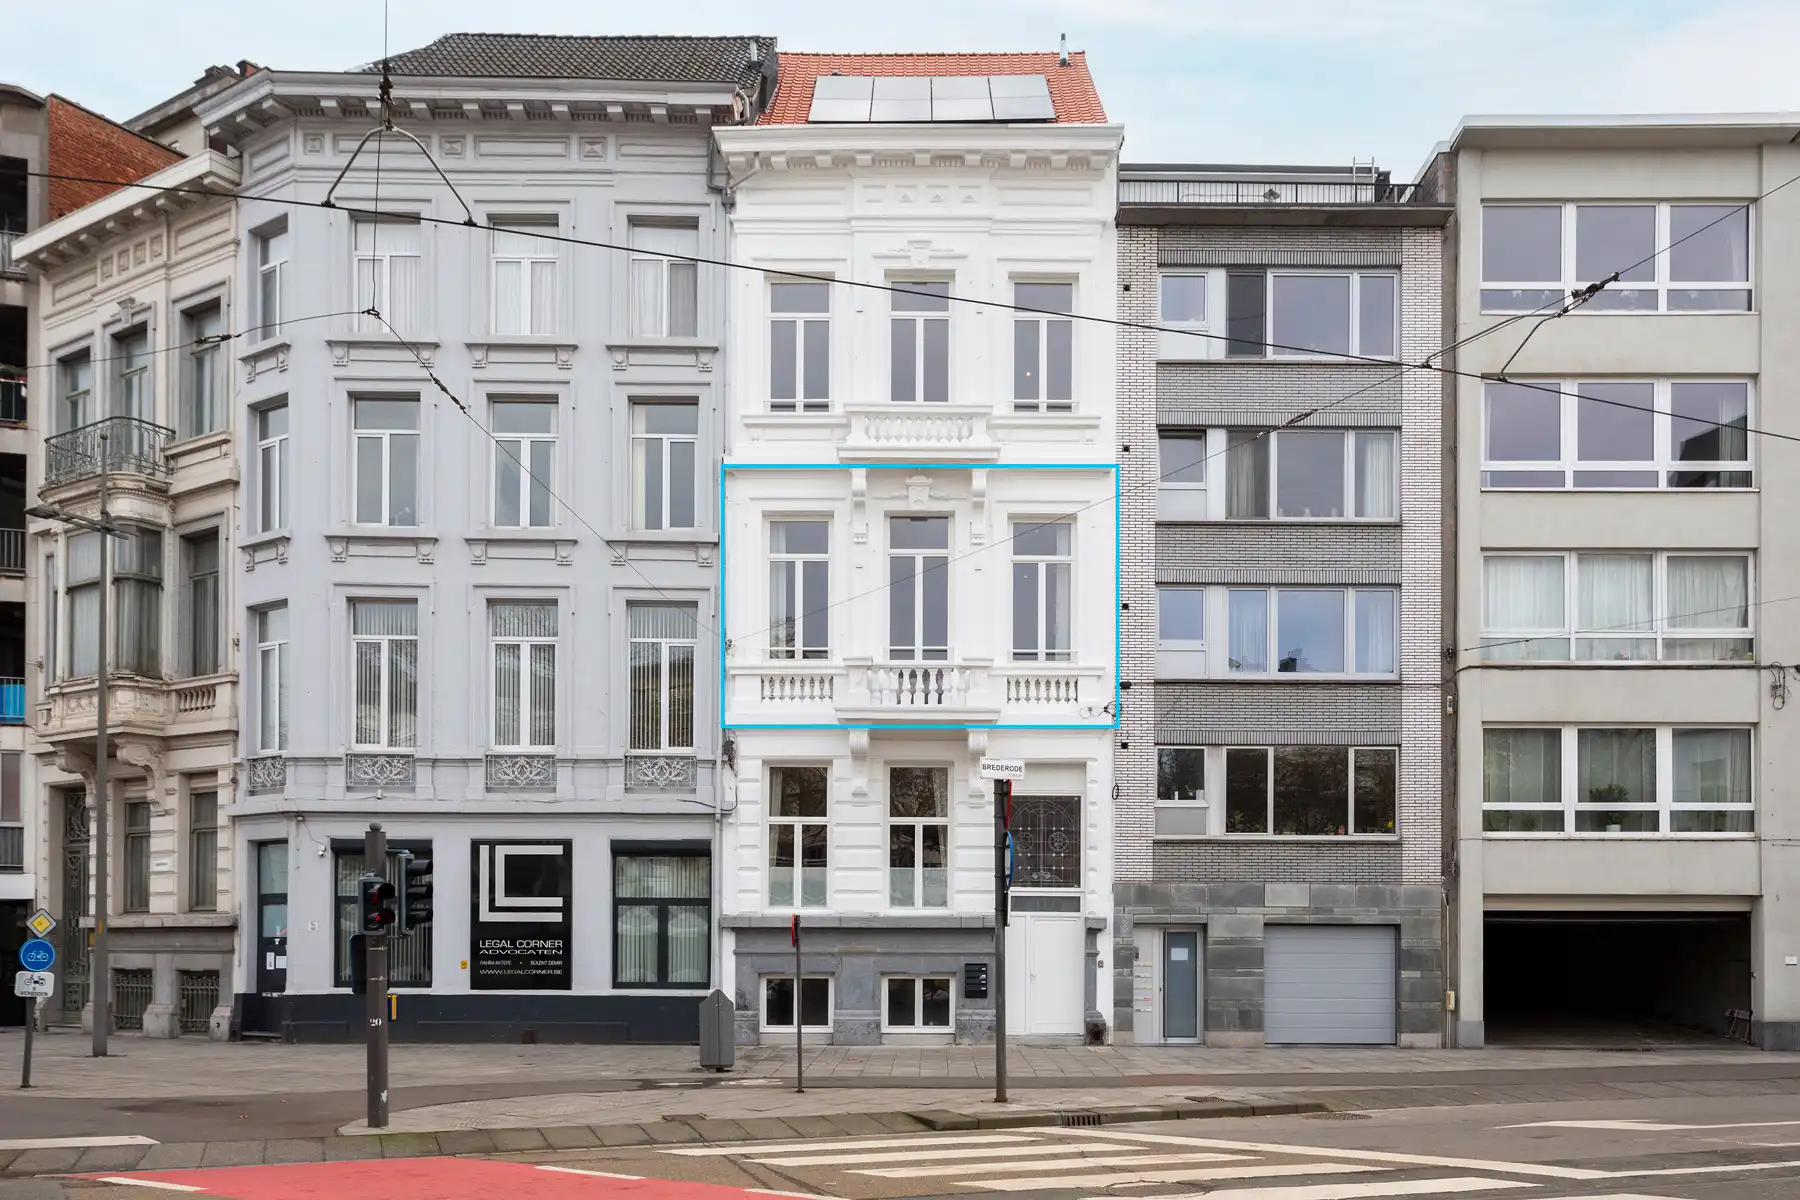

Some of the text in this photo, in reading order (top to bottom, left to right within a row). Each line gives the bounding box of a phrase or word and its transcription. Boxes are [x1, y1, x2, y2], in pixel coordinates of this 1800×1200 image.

[982, 763, 1023, 772] BREDERODE
[479, 939, 563, 948] LEGAL CORNER
